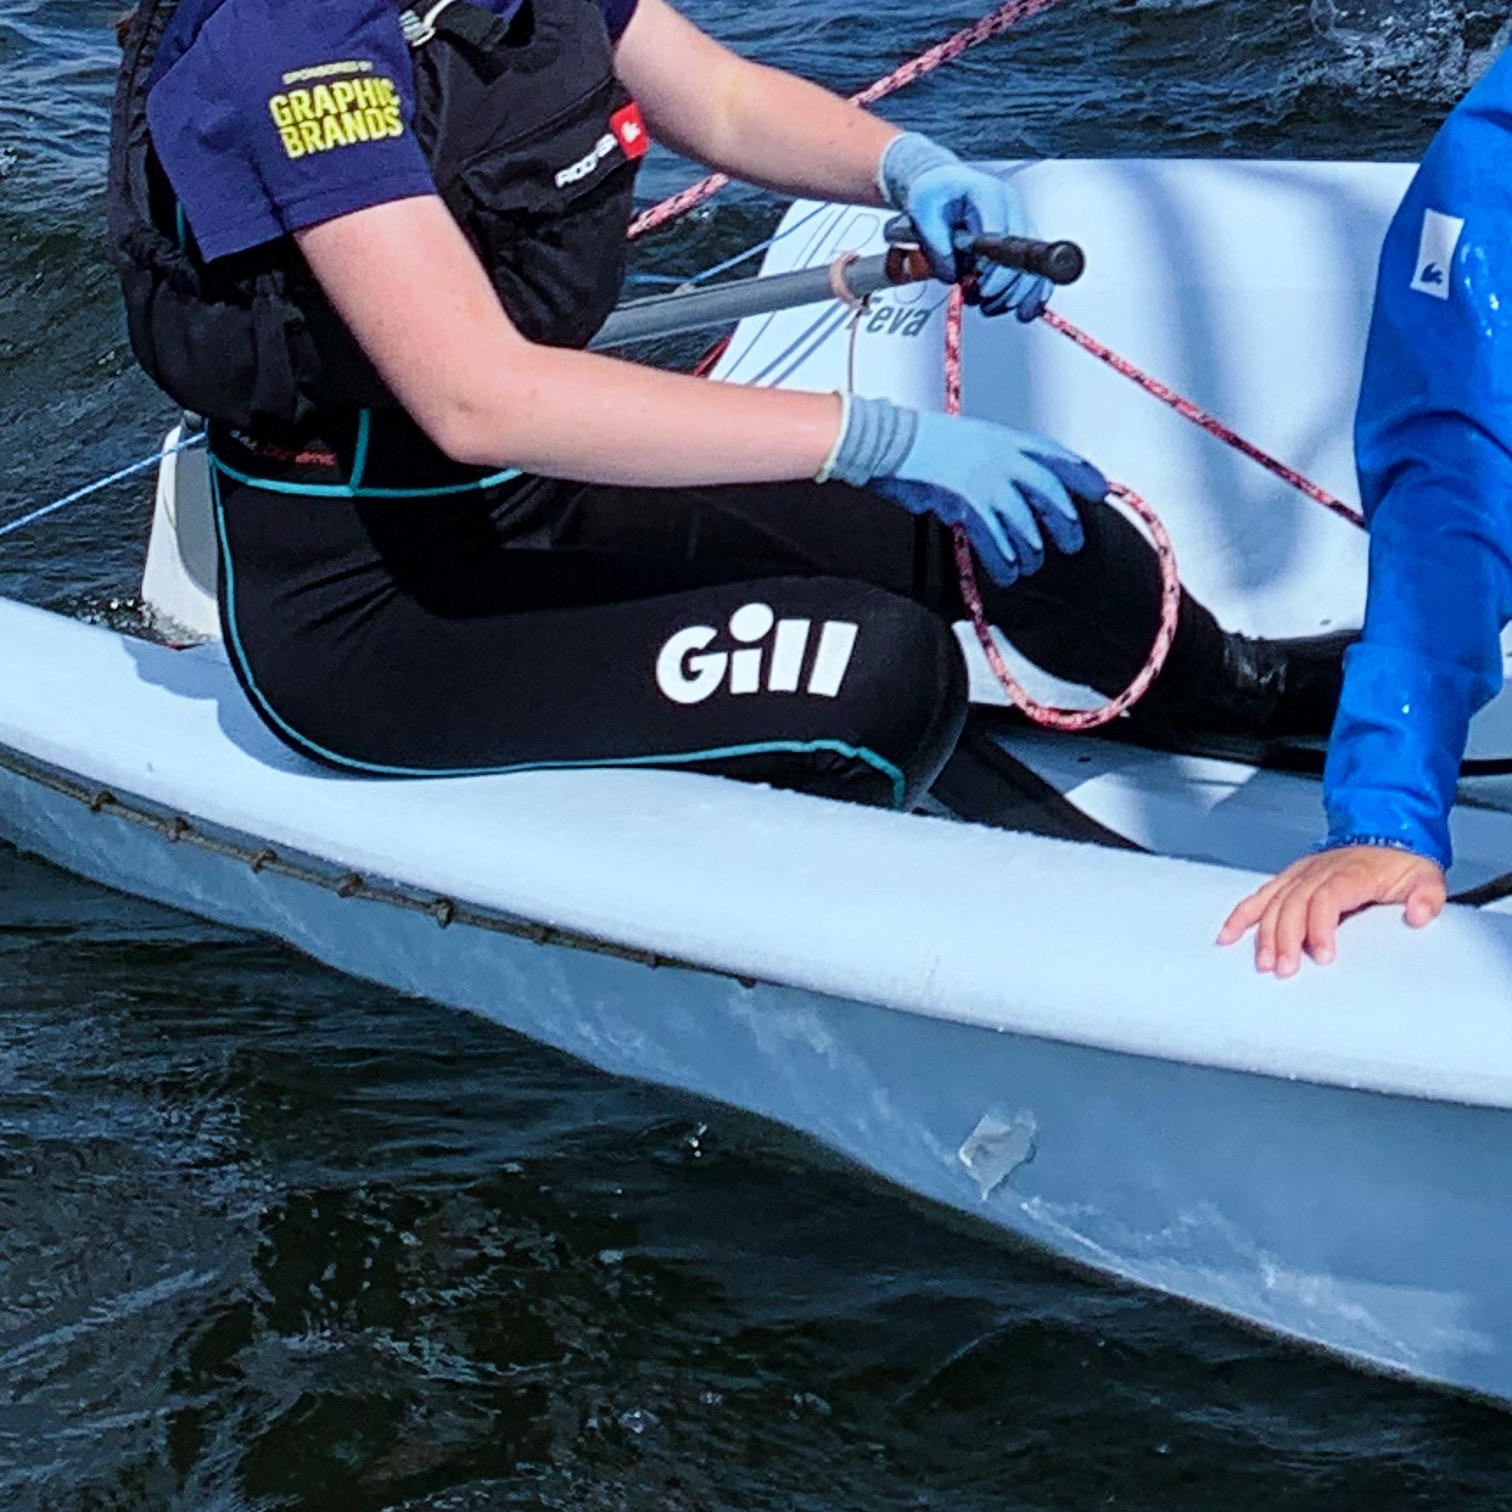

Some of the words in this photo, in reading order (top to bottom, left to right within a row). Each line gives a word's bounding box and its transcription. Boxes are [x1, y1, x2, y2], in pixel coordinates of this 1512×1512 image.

[269, 77, 400, 128] GRAPHIC
[279, 106, 404, 159] BRANDS
[656, 602, 858, 704] Gill
